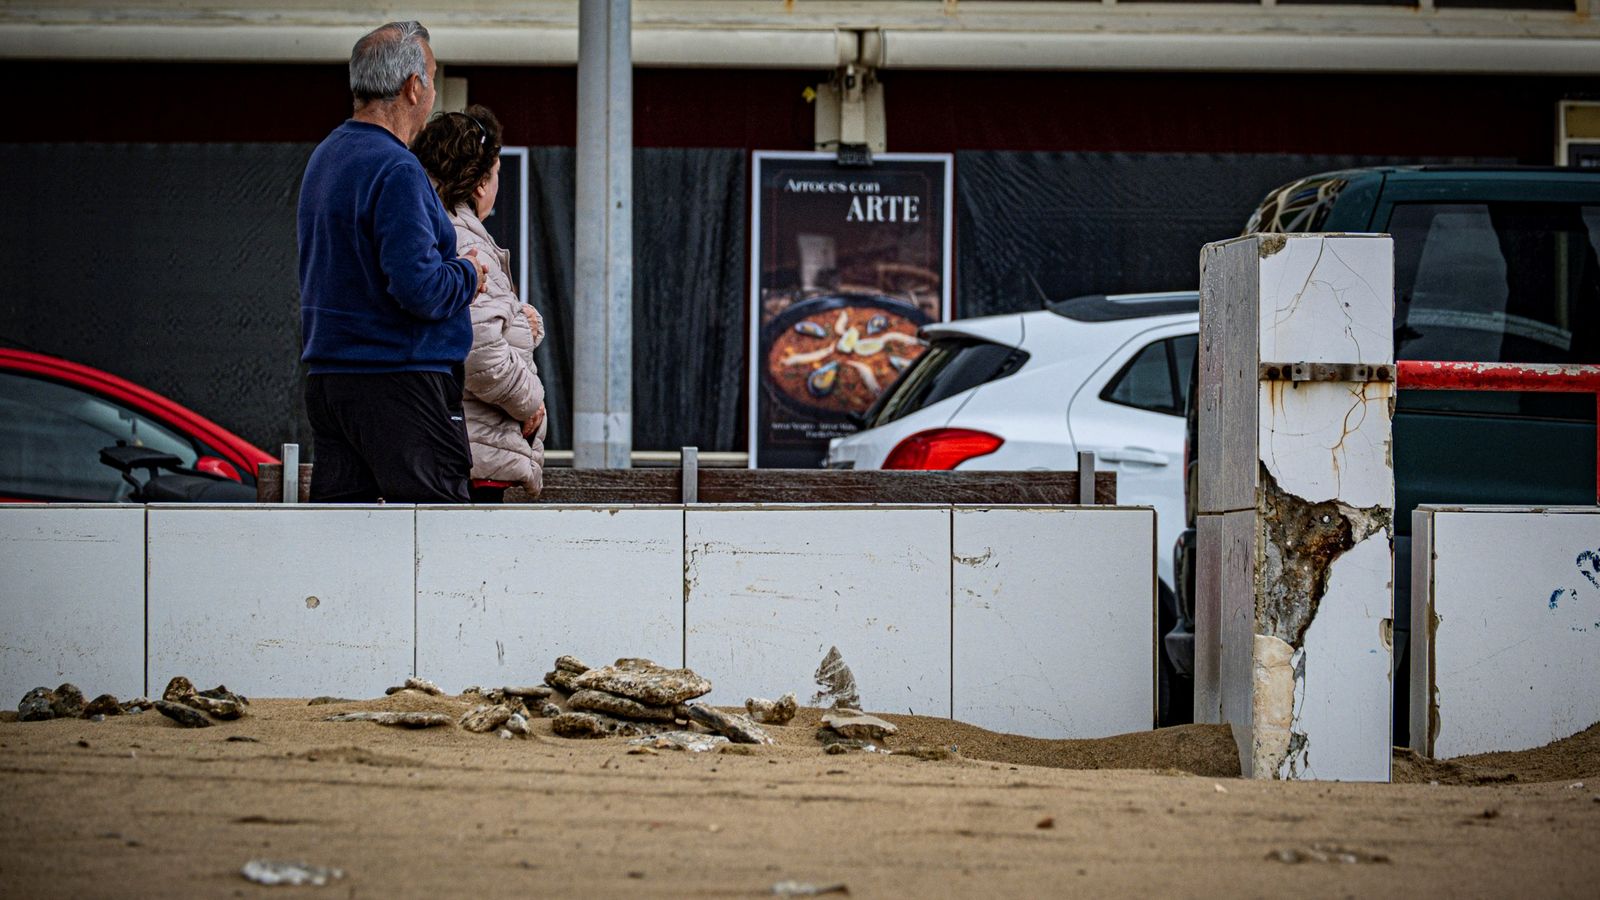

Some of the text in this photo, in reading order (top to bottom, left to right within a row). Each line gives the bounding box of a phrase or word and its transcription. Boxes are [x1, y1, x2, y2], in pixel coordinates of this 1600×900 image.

[784, 178, 881, 192] Arroces con
[846, 195, 920, 222] ARTE
